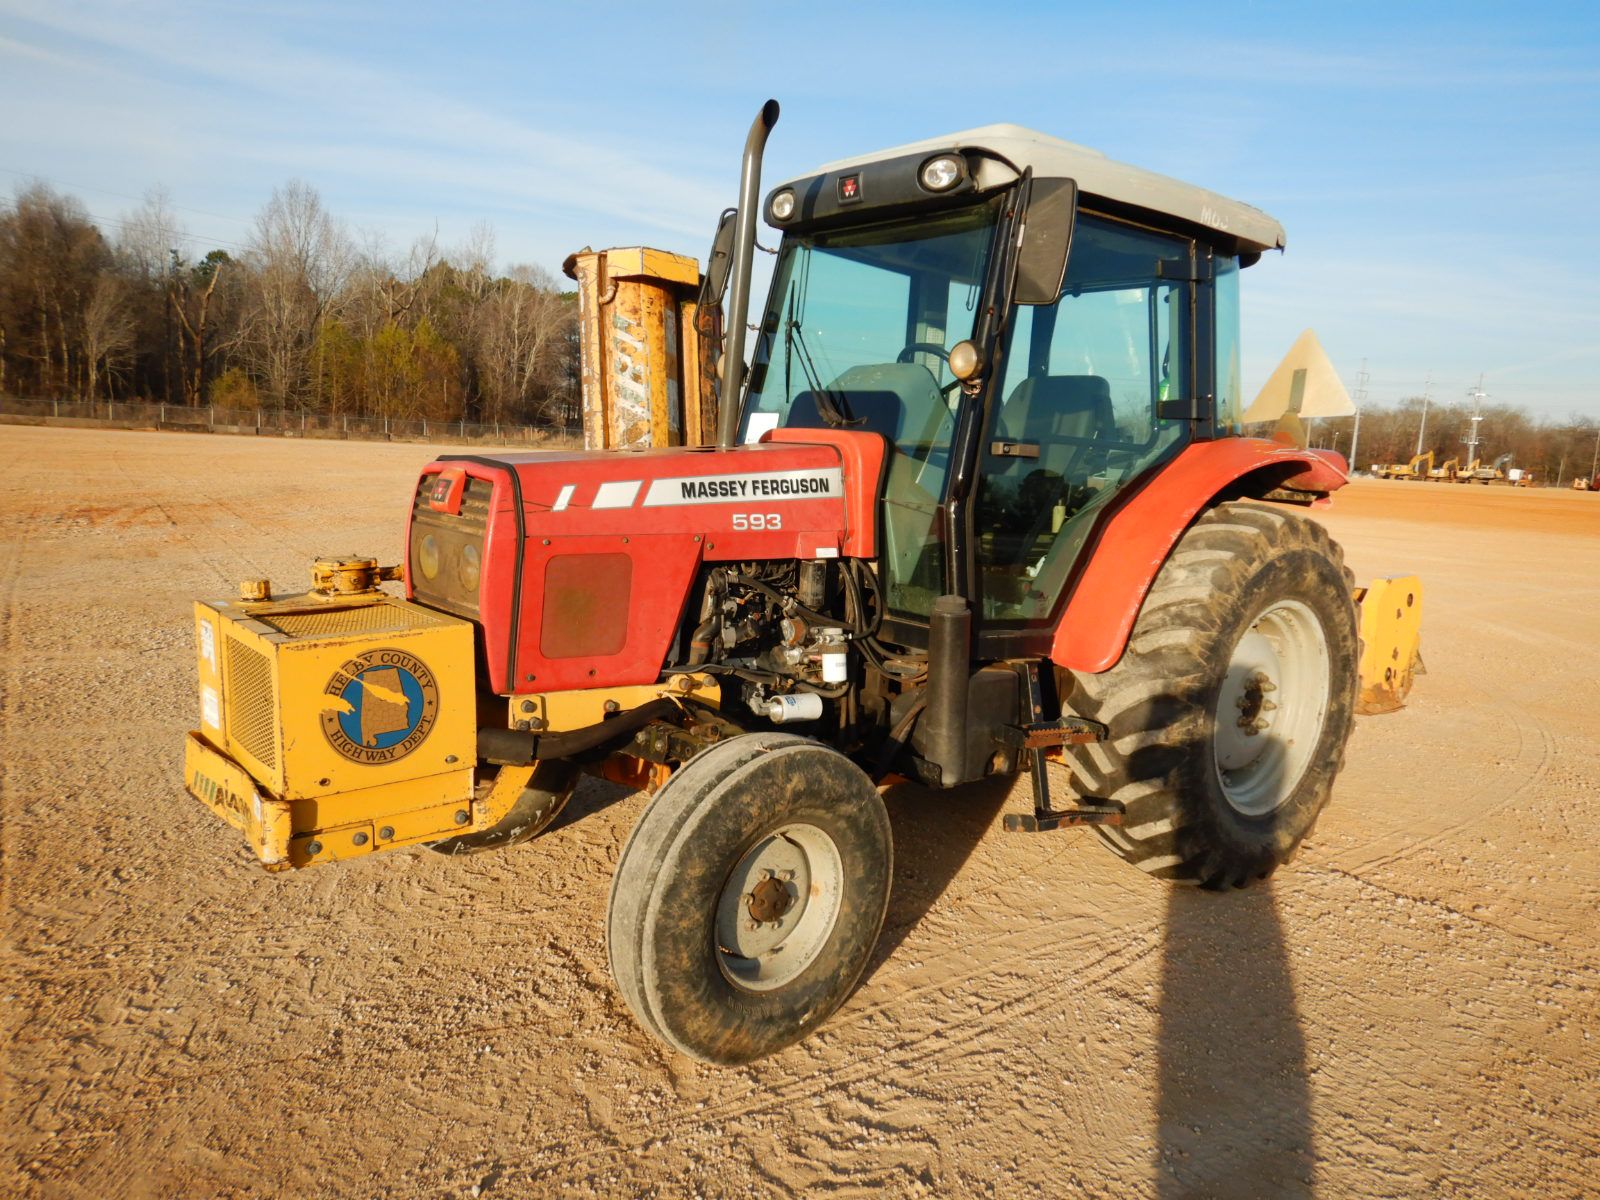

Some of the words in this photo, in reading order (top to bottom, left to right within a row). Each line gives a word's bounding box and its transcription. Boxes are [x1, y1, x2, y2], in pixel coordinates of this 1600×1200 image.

[681, 480, 747, 498] MASSEY
[752, 478, 829, 496] FERGUSON
[732, 513, 782, 531] 593
[329, 654, 374, 698] HELBY
[380, 652, 433, 690] COUNTY
[330, 729, 396, 762] HIGHWAY
